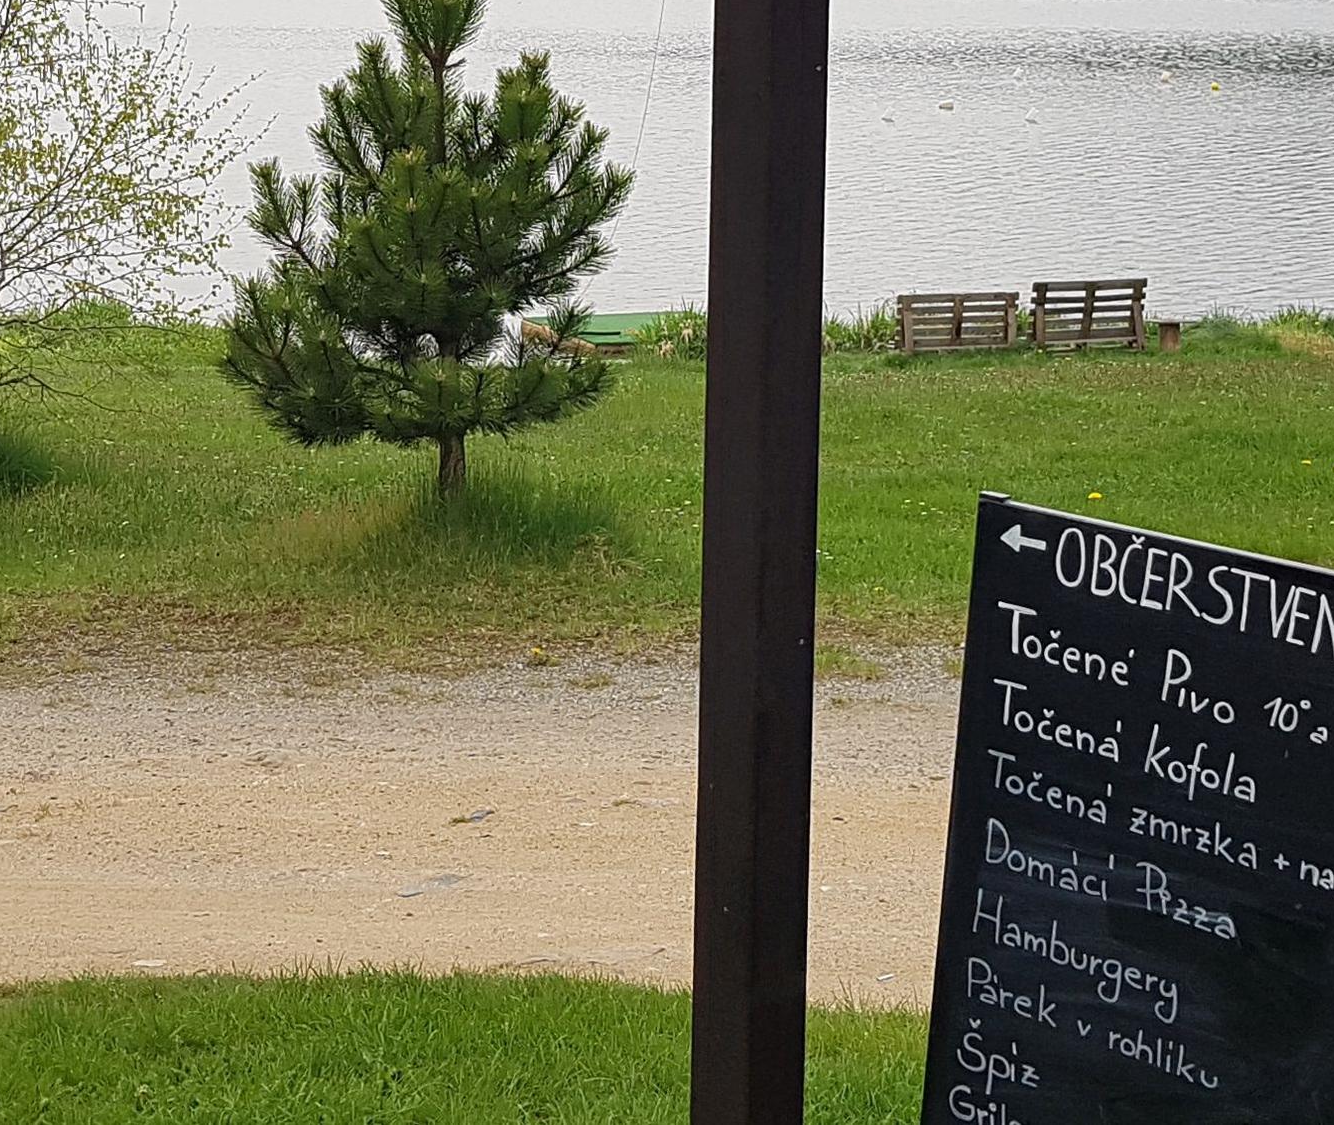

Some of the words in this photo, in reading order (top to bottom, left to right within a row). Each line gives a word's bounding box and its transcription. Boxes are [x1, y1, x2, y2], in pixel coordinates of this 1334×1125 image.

[998, 601, 1136, 687] Točené
[1161, 648, 1235, 724] Pivo
[1310, 726, 1328, 744] a
[994, 678, 1123, 763] Točená
[1144, 724, 1257, 803] kofola
[987, 749, 1113, 826] Točená
[1130, 805, 1258, 870] zmrzka
[1274, 853, 1289, 871] +
[984, 818, 1115, 903] Domácí
[1136, 861, 1238, 940] Pizza
[971, 887, 1181, 1024] Hamburgery
[966, 957, 1058, 1028] Párek
[1077, 1019, 1092, 1037] v
[1108, 1026, 1219, 1090] rohlíku
[949, 1084, 1021, 1125] Gril
